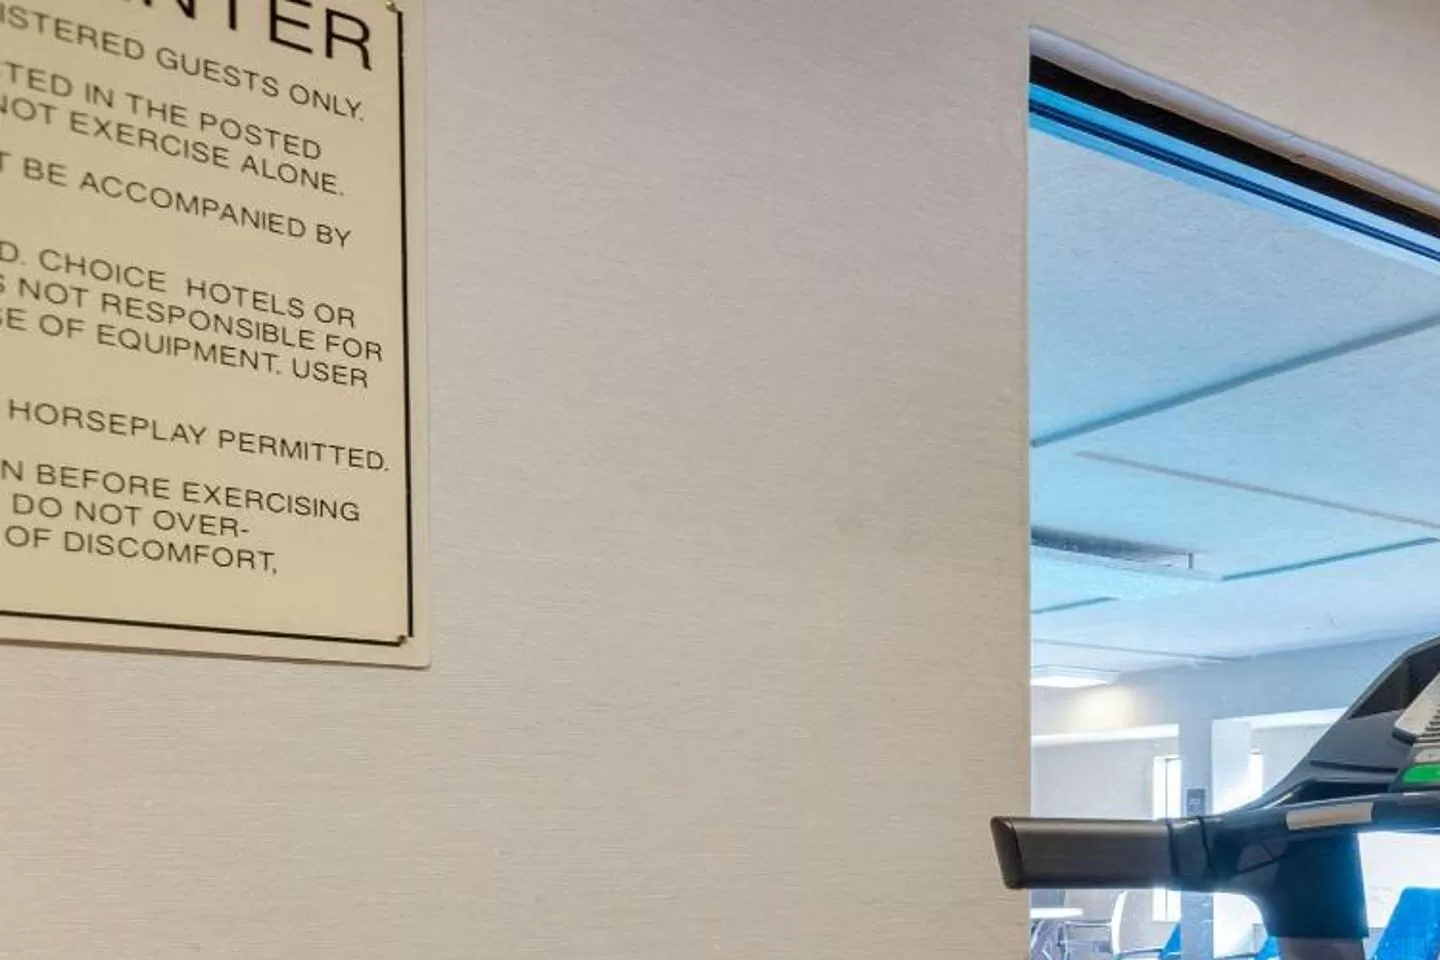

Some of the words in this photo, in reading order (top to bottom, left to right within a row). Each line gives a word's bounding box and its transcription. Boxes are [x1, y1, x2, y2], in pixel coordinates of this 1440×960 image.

[85, 82, 114, 108] IN
[125, 92, 188, 128] THE
[199, 111, 322, 161] POSTED
[155, 47, 280, 98] GUESTS
[288, 83, 365, 122] ONLY.
[69, 110, 230, 170] EXERCISE
[240, 154, 345, 197] ALONE.
[23, 156, 67, 188] BE
[78, 171, 307, 239] ACCOMPANIED
[315, 223, 352, 249] BY
[18, 277, 89, 309] NOT
[101, 292, 316, 351] RESPONSIBLE
[325, 333, 383, 363] FOR
[38, 248, 167, 293] CHOICE
[185, 277, 305, 320] HOTELS
[313, 302, 356, 329] OR
[38, 313, 85, 339] OF
[96, 323, 282, 376] EQUIPMENT.
[291, 357, 368, 389] USER
[8, 398, 208, 445] HORSEPLAY
[218, 428, 389, 472] PERMITTED.
[12, 492, 63, 519] DO
[75, 500, 143, 527] NOT
[152, 509, 250, 538] OVER-
[36, 463, 171, 500] BEFORE
[182, 481, 360, 522] EXERCISING
[4, 524, 53, 549] OF
